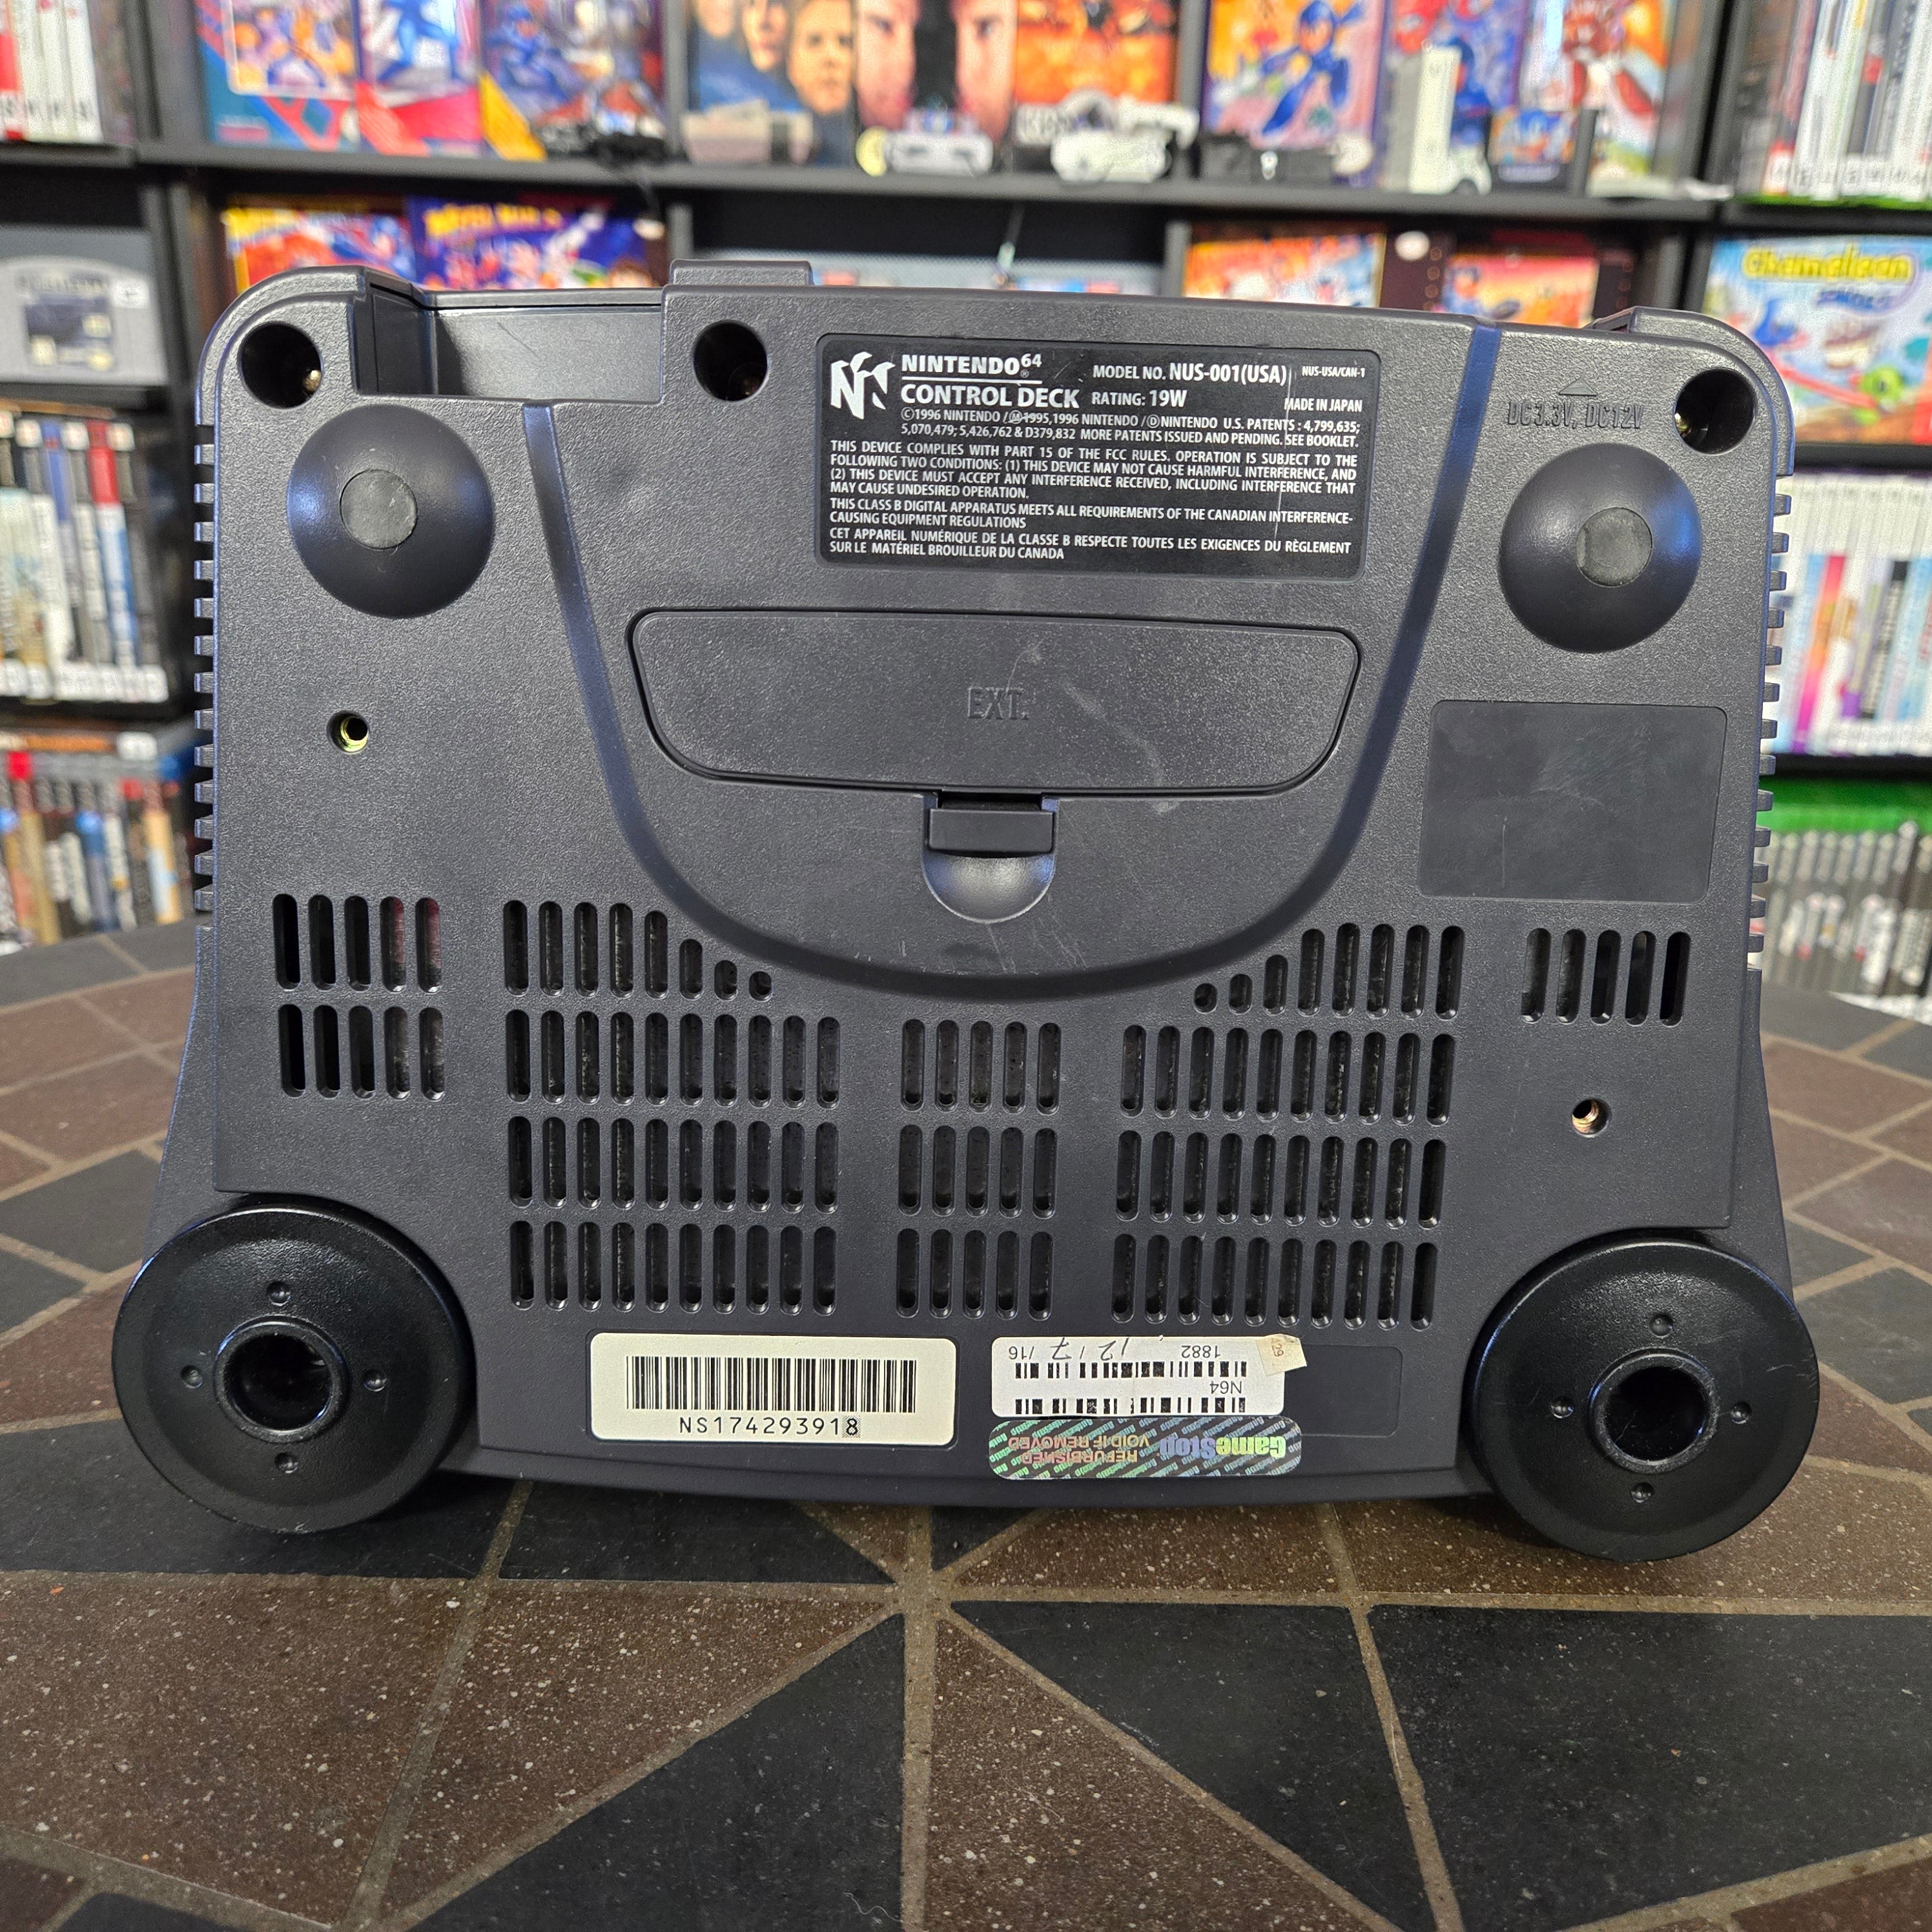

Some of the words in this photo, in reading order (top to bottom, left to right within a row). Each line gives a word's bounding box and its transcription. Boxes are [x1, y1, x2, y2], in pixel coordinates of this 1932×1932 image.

[1093, 365, 1139, 379] MODEL
[1142, 366, 1166, 380] NO.
[1169, 362, 1287, 385] NUS-001(USA)
[1302, 366, 1365, 378] NUS-USA/CAN-1
[901, 384, 1012, 407] CONTROL
[1018, 388, 1080, 408] DECK
[1092, 392, 1146, 406] RATING:
[1149, 389, 1187, 407] 19W
[1284, 398, 1314, 411] MADE
[1316, 399, 1327, 412] IN
[1330, 400, 1362, 413] JAPAN
[943, 409, 1001, 423] NINTENDO
[1081, 413, 1139, 427] NINTENDO
[1223, 417, 1244, 429] U.S.
[1247, 418, 1295, 431] PATENTS
[1303, 420, 1361, 433] 4,799,635;
[1585, 403, 1645, 429] DC12V
[901, 424, 958, 437] 5,070,479;
[959, 425, 1012, 438] 5,426,762
[1014, 426, 1023, 438] &
[1025, 427, 1076, 440] D379,832
[1080, 428, 1113, 441] MORE
[1114, 429, 1162, 442] PATENTS
[1164, 431, 1204, 444] ISSUED
[1205, 432, 1229, 444] AND
[1231, 433, 1283, 446] PENDING.
[1286, 434, 1304, 446] SEE
[1306, 435, 1359, 447] BOOKLET.
[830, 440, 857, 453] THIS
[861, 441, 902, 454] DEVICE
[907, 442, 964, 455] COMPLIES
[969, 444, 1000, 457] WITH
[1004, 445, 1034, 457] PART
[1040, 446, 1054, 458] 15
[1057, 446, 1074, 458] OF
[1078, 447, 1101, 459] THE
[1105, 447, 1127, 460] FCC
[1131, 449, 1171, 461] RULES.
[1175, 449, 1242, 463] OPERATION
[1246, 451, 1257, 464] IS
[1260, 452, 1310, 465] SUBJECT
[1315, 453, 1331, 466] TO
[1335, 454, 1357, 466] THE
[830, 453, 898, 467] FOLLOWING
[899, 455, 927, 468] TWO
[929, 457, 1003, 470] CONDITIONS:
[1005, 458, 1020, 471] (1)
[1022, 459, 1049, 471] THIS
[1051, 460, 1091, 473] DEVICE
[1093, 461, 1120, 473] MAY
[1121, 462, 1146, 474] NOT
[1147, 462, 1185, 475] CAUSE
[1187, 464, 1242, 477] HARMFUL
[1244, 465, 1328, 479] INTERFERENCE,
[1331, 468, 1357, 480] AND
[830, 468, 846, 480] (2)
[848, 468, 876, 480] THIS
[878, 469, 919, 482] DEVICE
[921, 470, 955, 483] MUST
[958, 471, 1001, 484] ACCEPT
[1003, 473, 1029, 485] ANY
[1031, 473, 1112, 488] INTERFERENCE
[1115, 476, 1172, 489] RECEIVED,
[1175, 477, 1238, 491] INCLUDING
[1241, 479, 1321, 493] INTERFERENCE
[1326, 482, 1356, 494] THAT
[830, 481, 857, 494] MAY
[858, 482, 895, 495] CAUSE
[896, 483, 961, 497] UNDESIRED
[961, 485, 1029, 498] OPERATION.
[829, 497, 856, 510] THIS
[857, 498, 892, 511] CLASS
[893, 499, 902, 511] B
[903, 500, 948, 513] DIGITAL
[949, 501, 1016, 514] APPARATUS
[1018, 503, 1054, 515] MEETS
[1056, 504, 1078, 516] ALL
[1078, 504, 1165, 519] REQUIREMENTS
[1166, 507, 1182, 519] OF
[1183, 508, 1206, 520] THE
[1207, 508, 1267, 521] CANADIAN
[1269, 509, 1353, 524] INTERFERENCE-
[829, 511, 880, 524] CAUSING
[881, 513, 948, 526] EQUIPMENT
[949, 515, 1027, 528] REGULATIONS
[829, 527, 850, 539] CET
[854, 528, 907, 541] APPAREIL
[910, 527, 978, 543] NUMÉRIQUE
[981, 531, 997, 544] DE
[1000, 532, 1015, 544] LA
[1018, 533, 1059, 545] CLASSE
[1062, 534, 1071, 546] B
[1074, 534, 1128, 547] RESPECTE
[1131, 535, 1175, 548] TOUTES
[1177, 537, 1197, 549] LES
[1200, 538, 1261, 551] EXIGENCES
[1264, 539, 1282, 551] DU
[1285, 537, 1351, 553] RÈGLEMENT
[829, 540, 852, 553] SUR
[854, 541, 867, 554] LE
[871, 539, 927, 556] MATÉRIEL
[927, 544, 997, 558] BROUILLEUR
[998, 546, 1016, 558] DU
[1017, 546, 1065, 560] CANADA
[1181, 1344, 1221, 1359] 1882
[1209, 1380, 1243, 1395] N64
[679, 1416, 861, 1439] NS174293918
[1007, 1435, 1089, 1450] REMOVED
[1092, 1435, 1107, 1448] IF
[1111, 1434, 1151, 1448] VOID
[1158, 1435, 1287, 1460] GameStop
[1021, 1449, 1139, 1465] REFURBISHED
